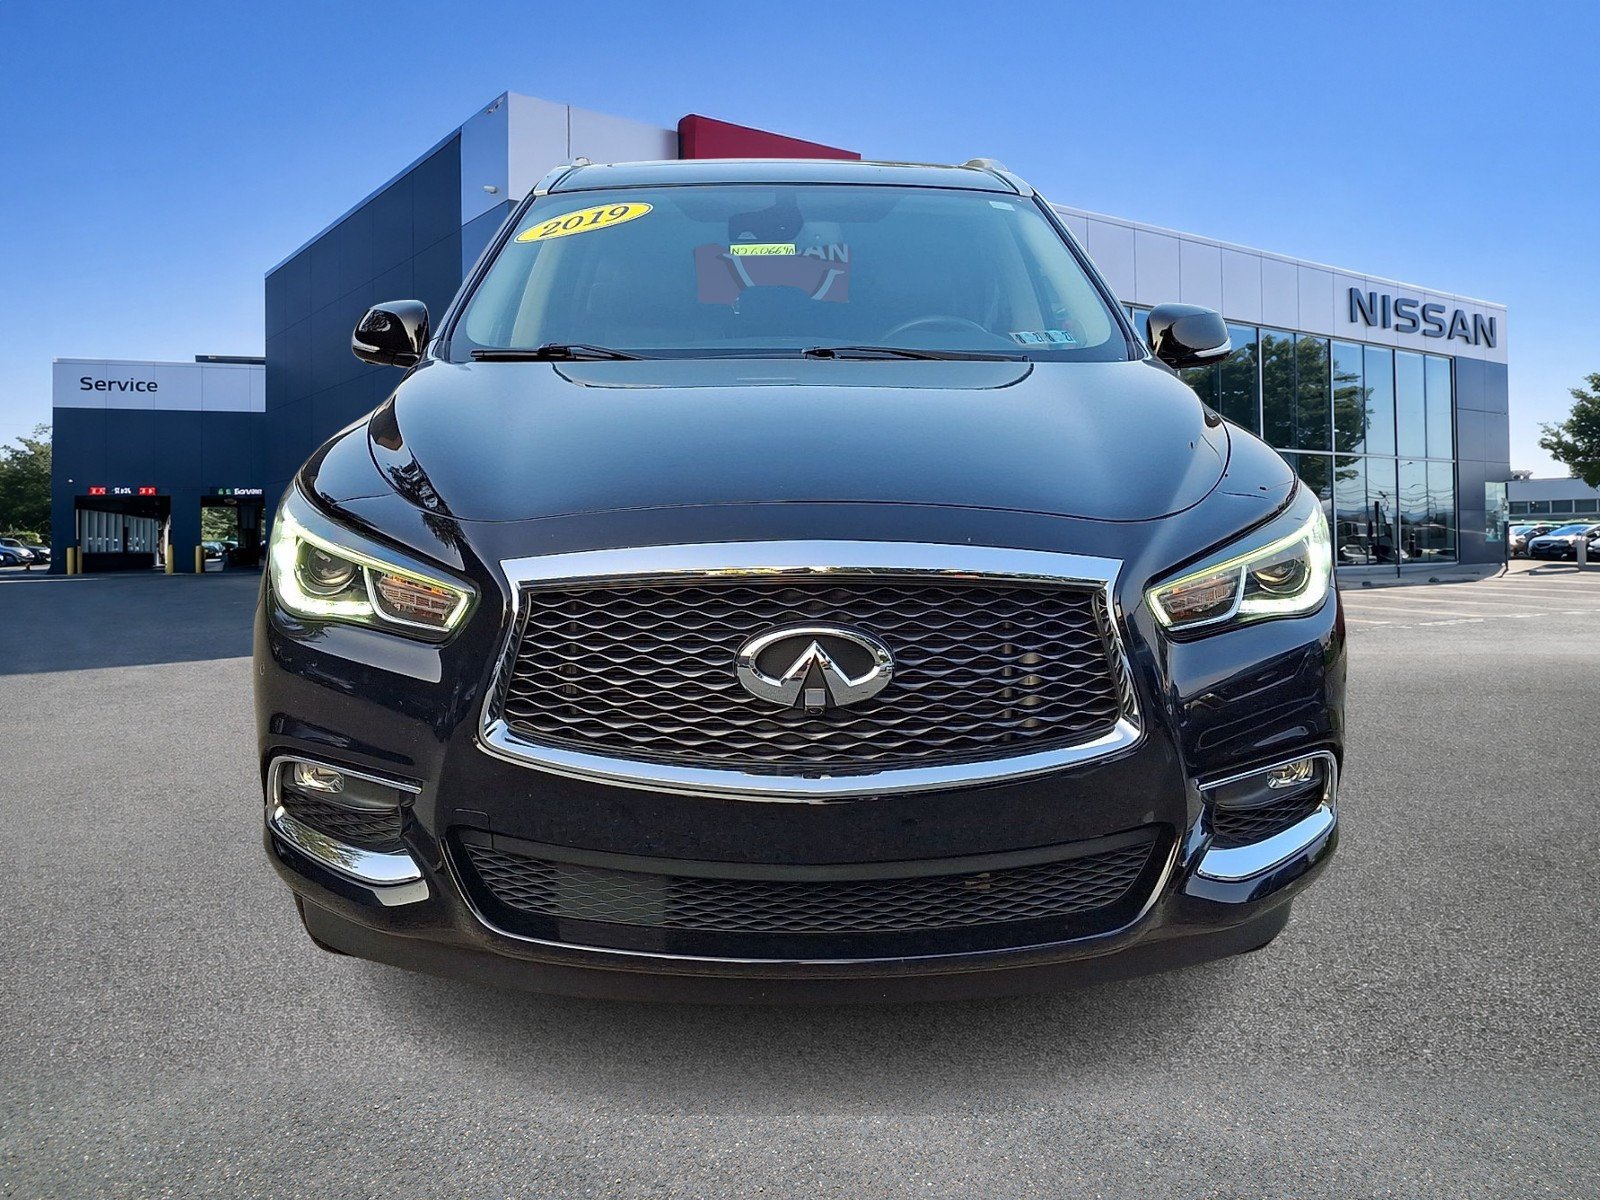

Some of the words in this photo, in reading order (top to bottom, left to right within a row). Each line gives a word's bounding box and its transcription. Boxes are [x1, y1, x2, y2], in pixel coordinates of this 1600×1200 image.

[539, 205, 630, 237] 2019
[1348, 287, 1497, 348] NISSAN
[79, 376, 159, 393] Service
